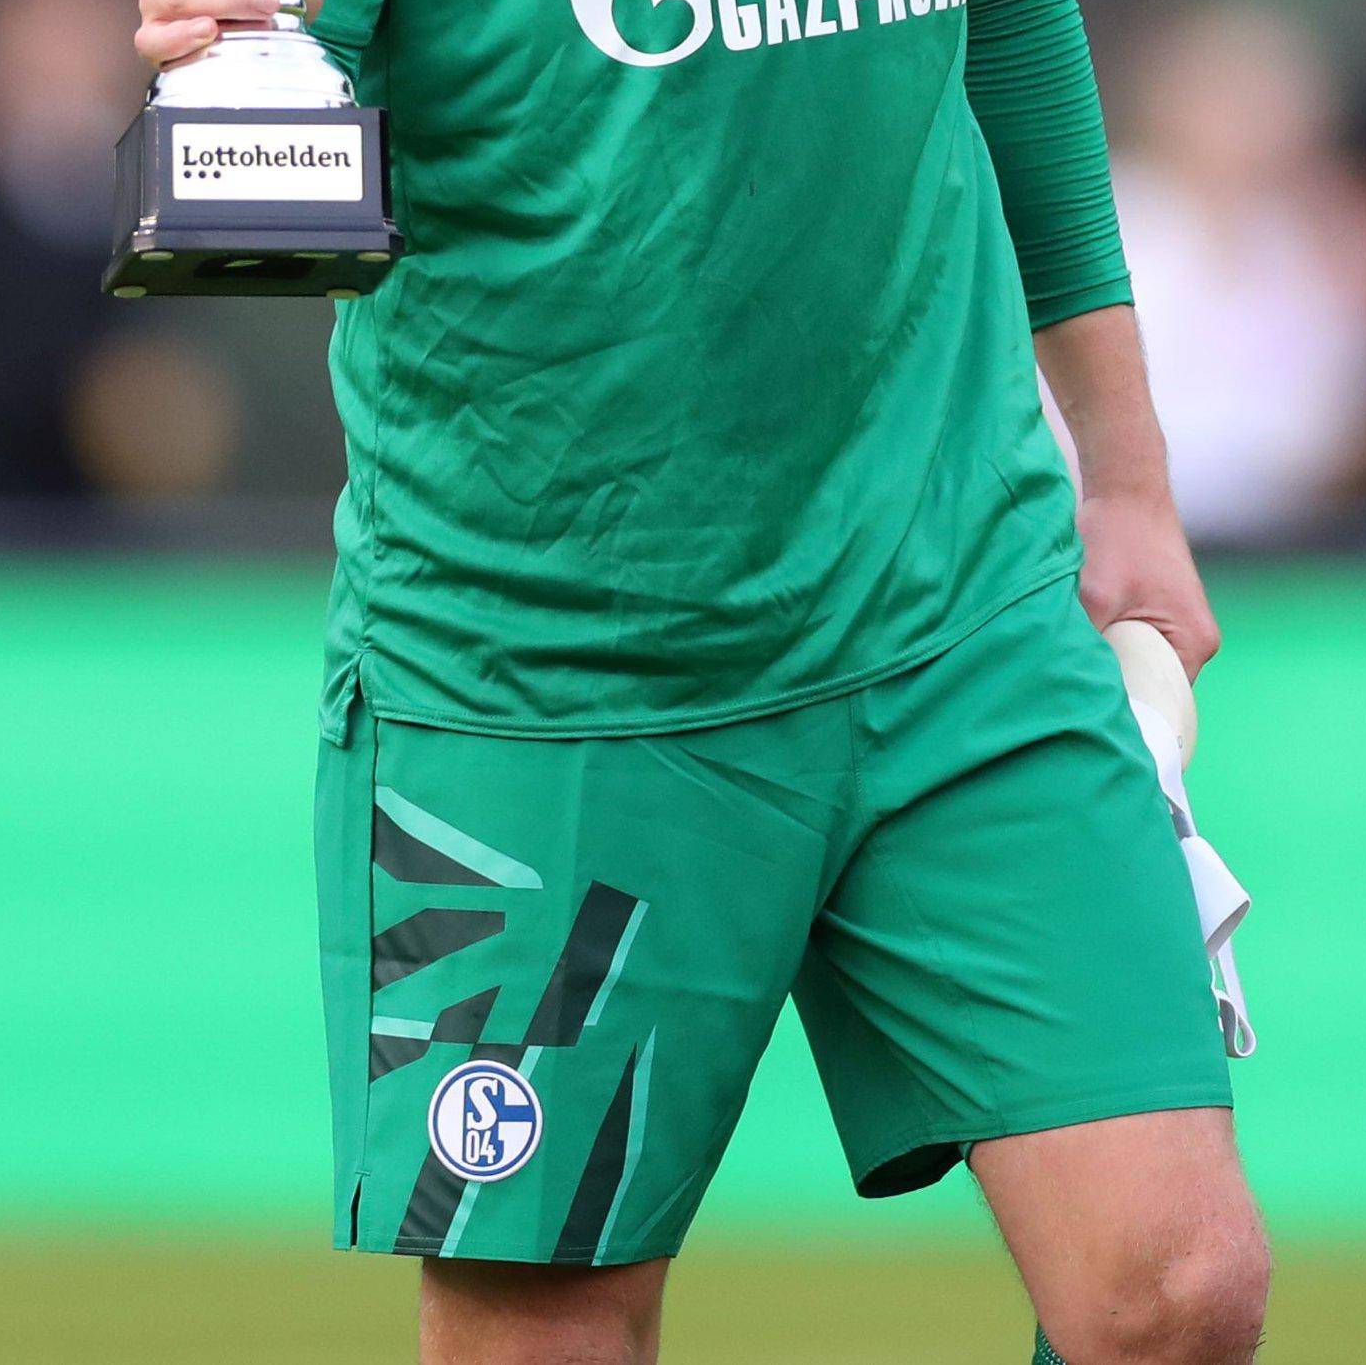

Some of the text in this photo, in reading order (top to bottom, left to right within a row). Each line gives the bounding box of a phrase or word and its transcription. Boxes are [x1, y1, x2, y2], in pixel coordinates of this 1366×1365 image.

[182, 145, 351, 167] Lottohelden
[466, 1078, 498, 1131] S
[465, 1129, 497, 1164] 04
